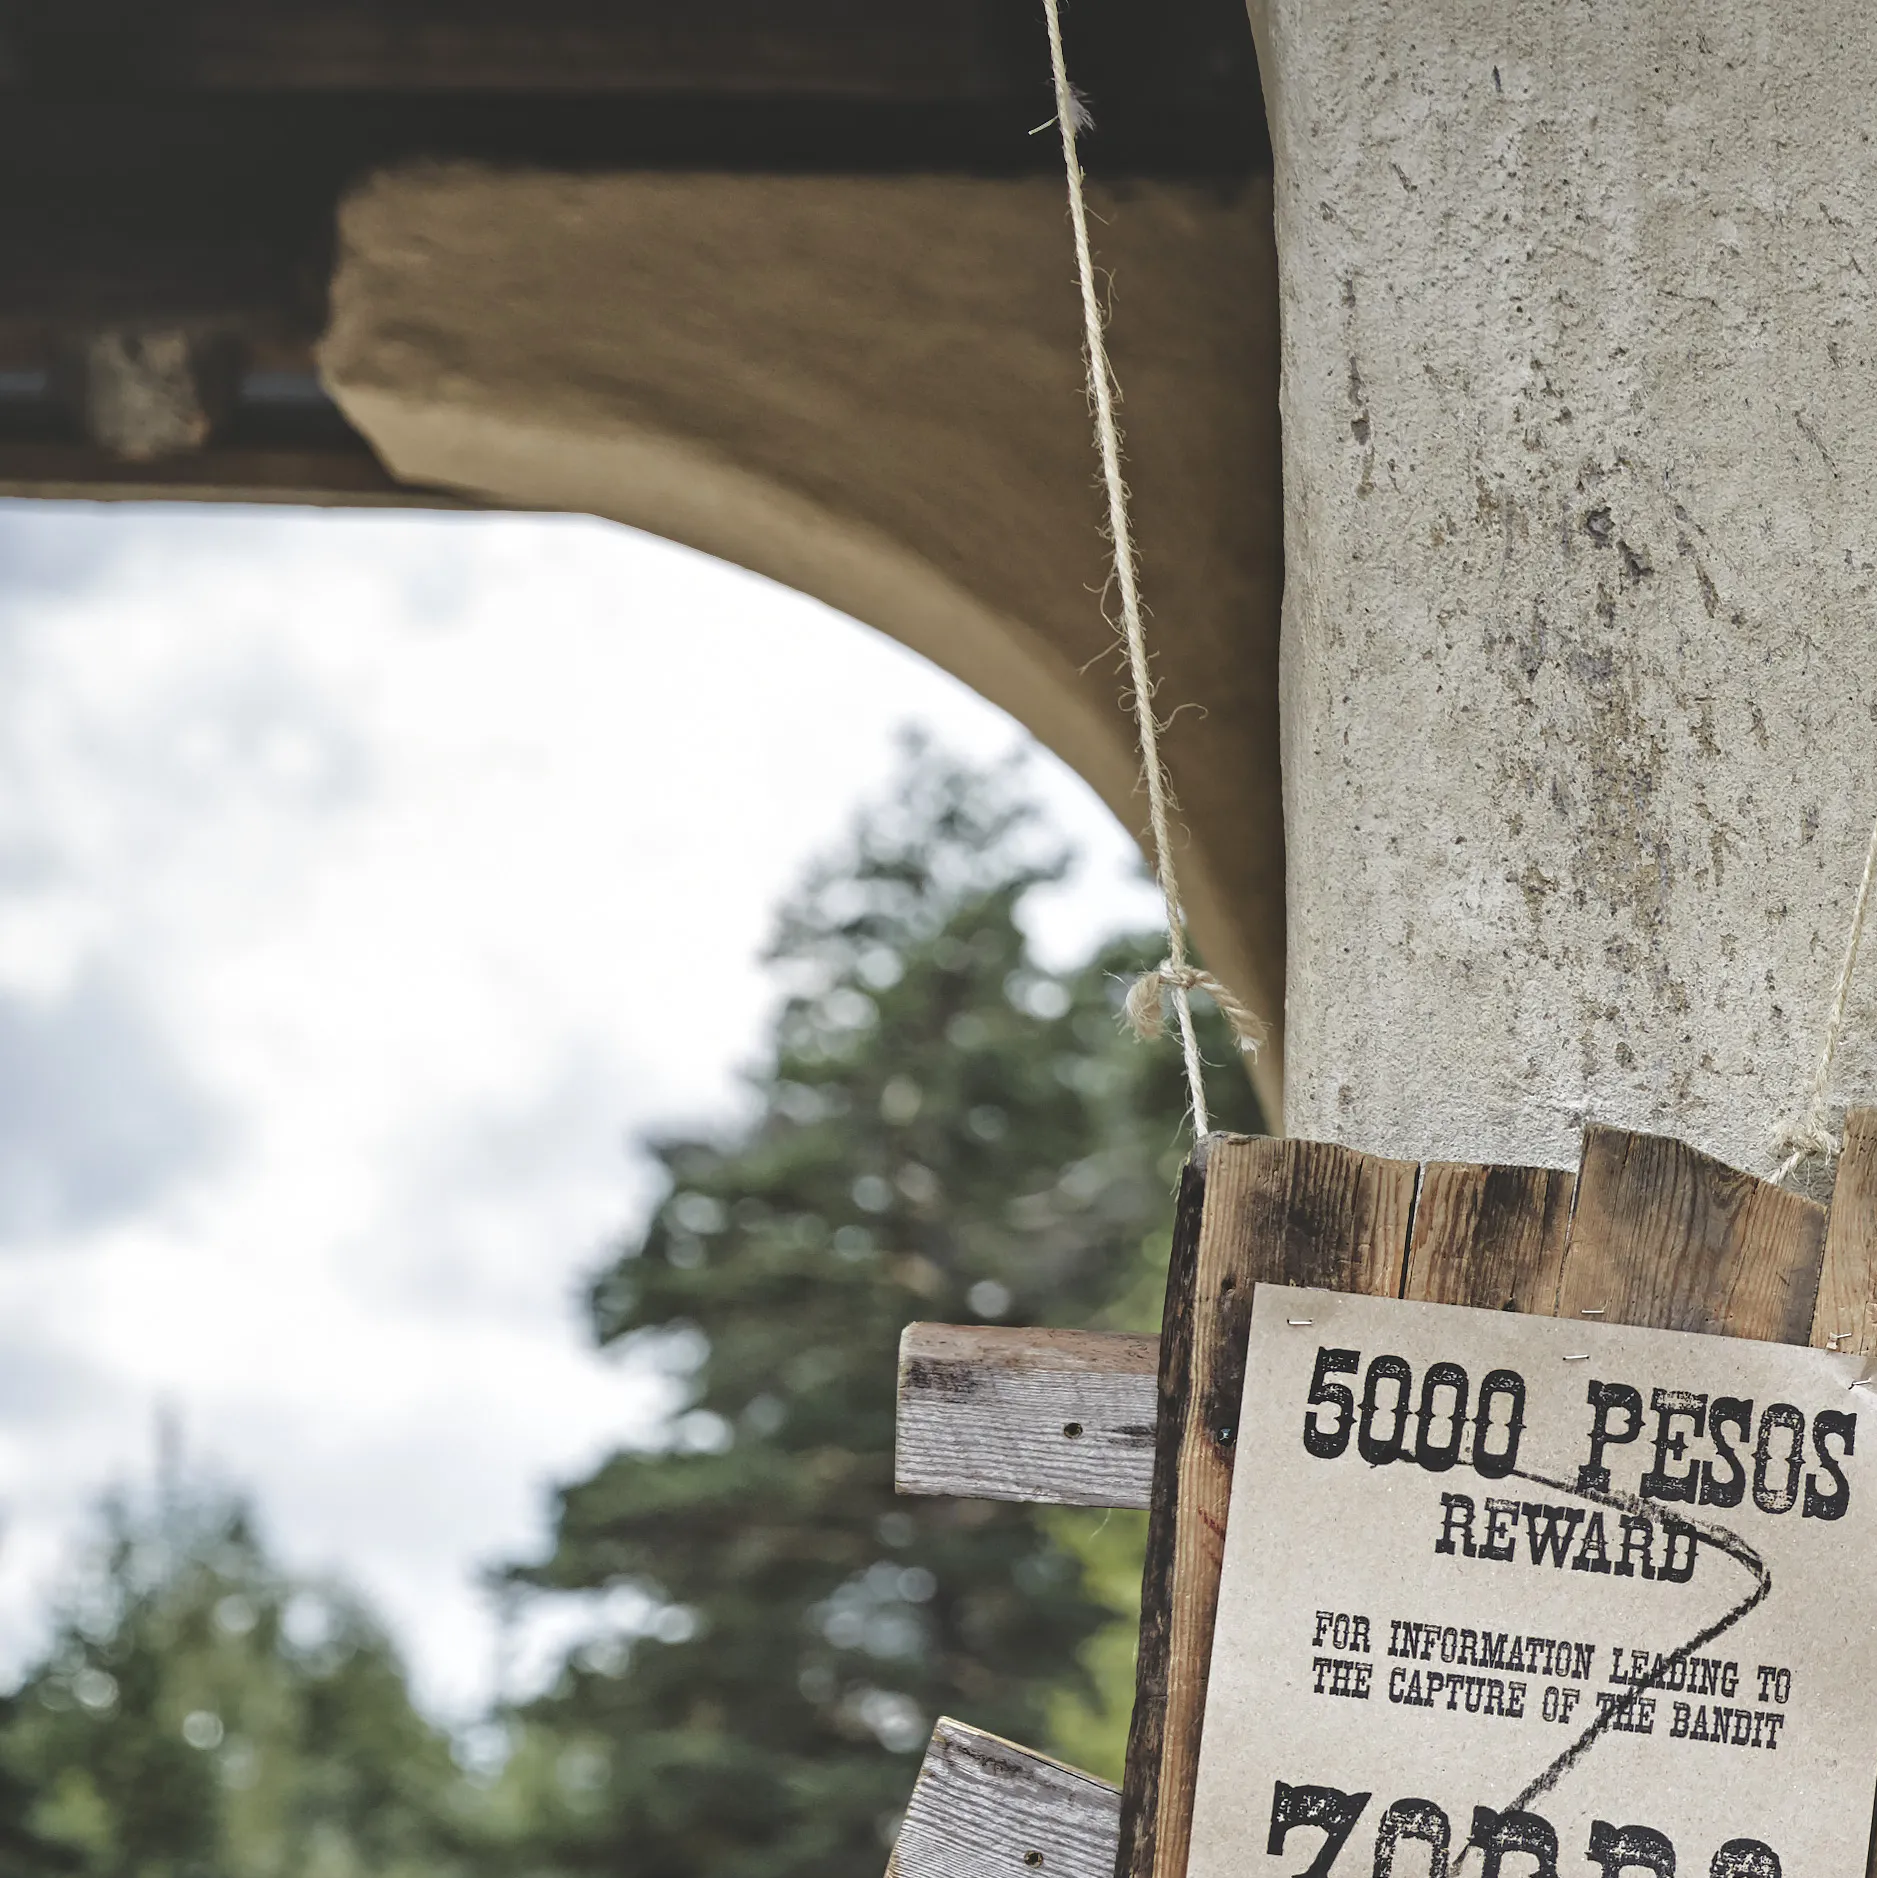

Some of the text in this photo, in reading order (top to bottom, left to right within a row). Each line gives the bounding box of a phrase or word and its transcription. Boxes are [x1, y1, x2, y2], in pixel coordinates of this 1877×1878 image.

[1302, 1346, 1858, 1521] 5000 PESOS
[1435, 1491, 1699, 1584] REWARD
[1312, 1610, 1792, 1704] FOR INFORMATION LEADING TO
[1312, 1657, 1785, 1750] THE CAPTURE OF THE BANDIT
